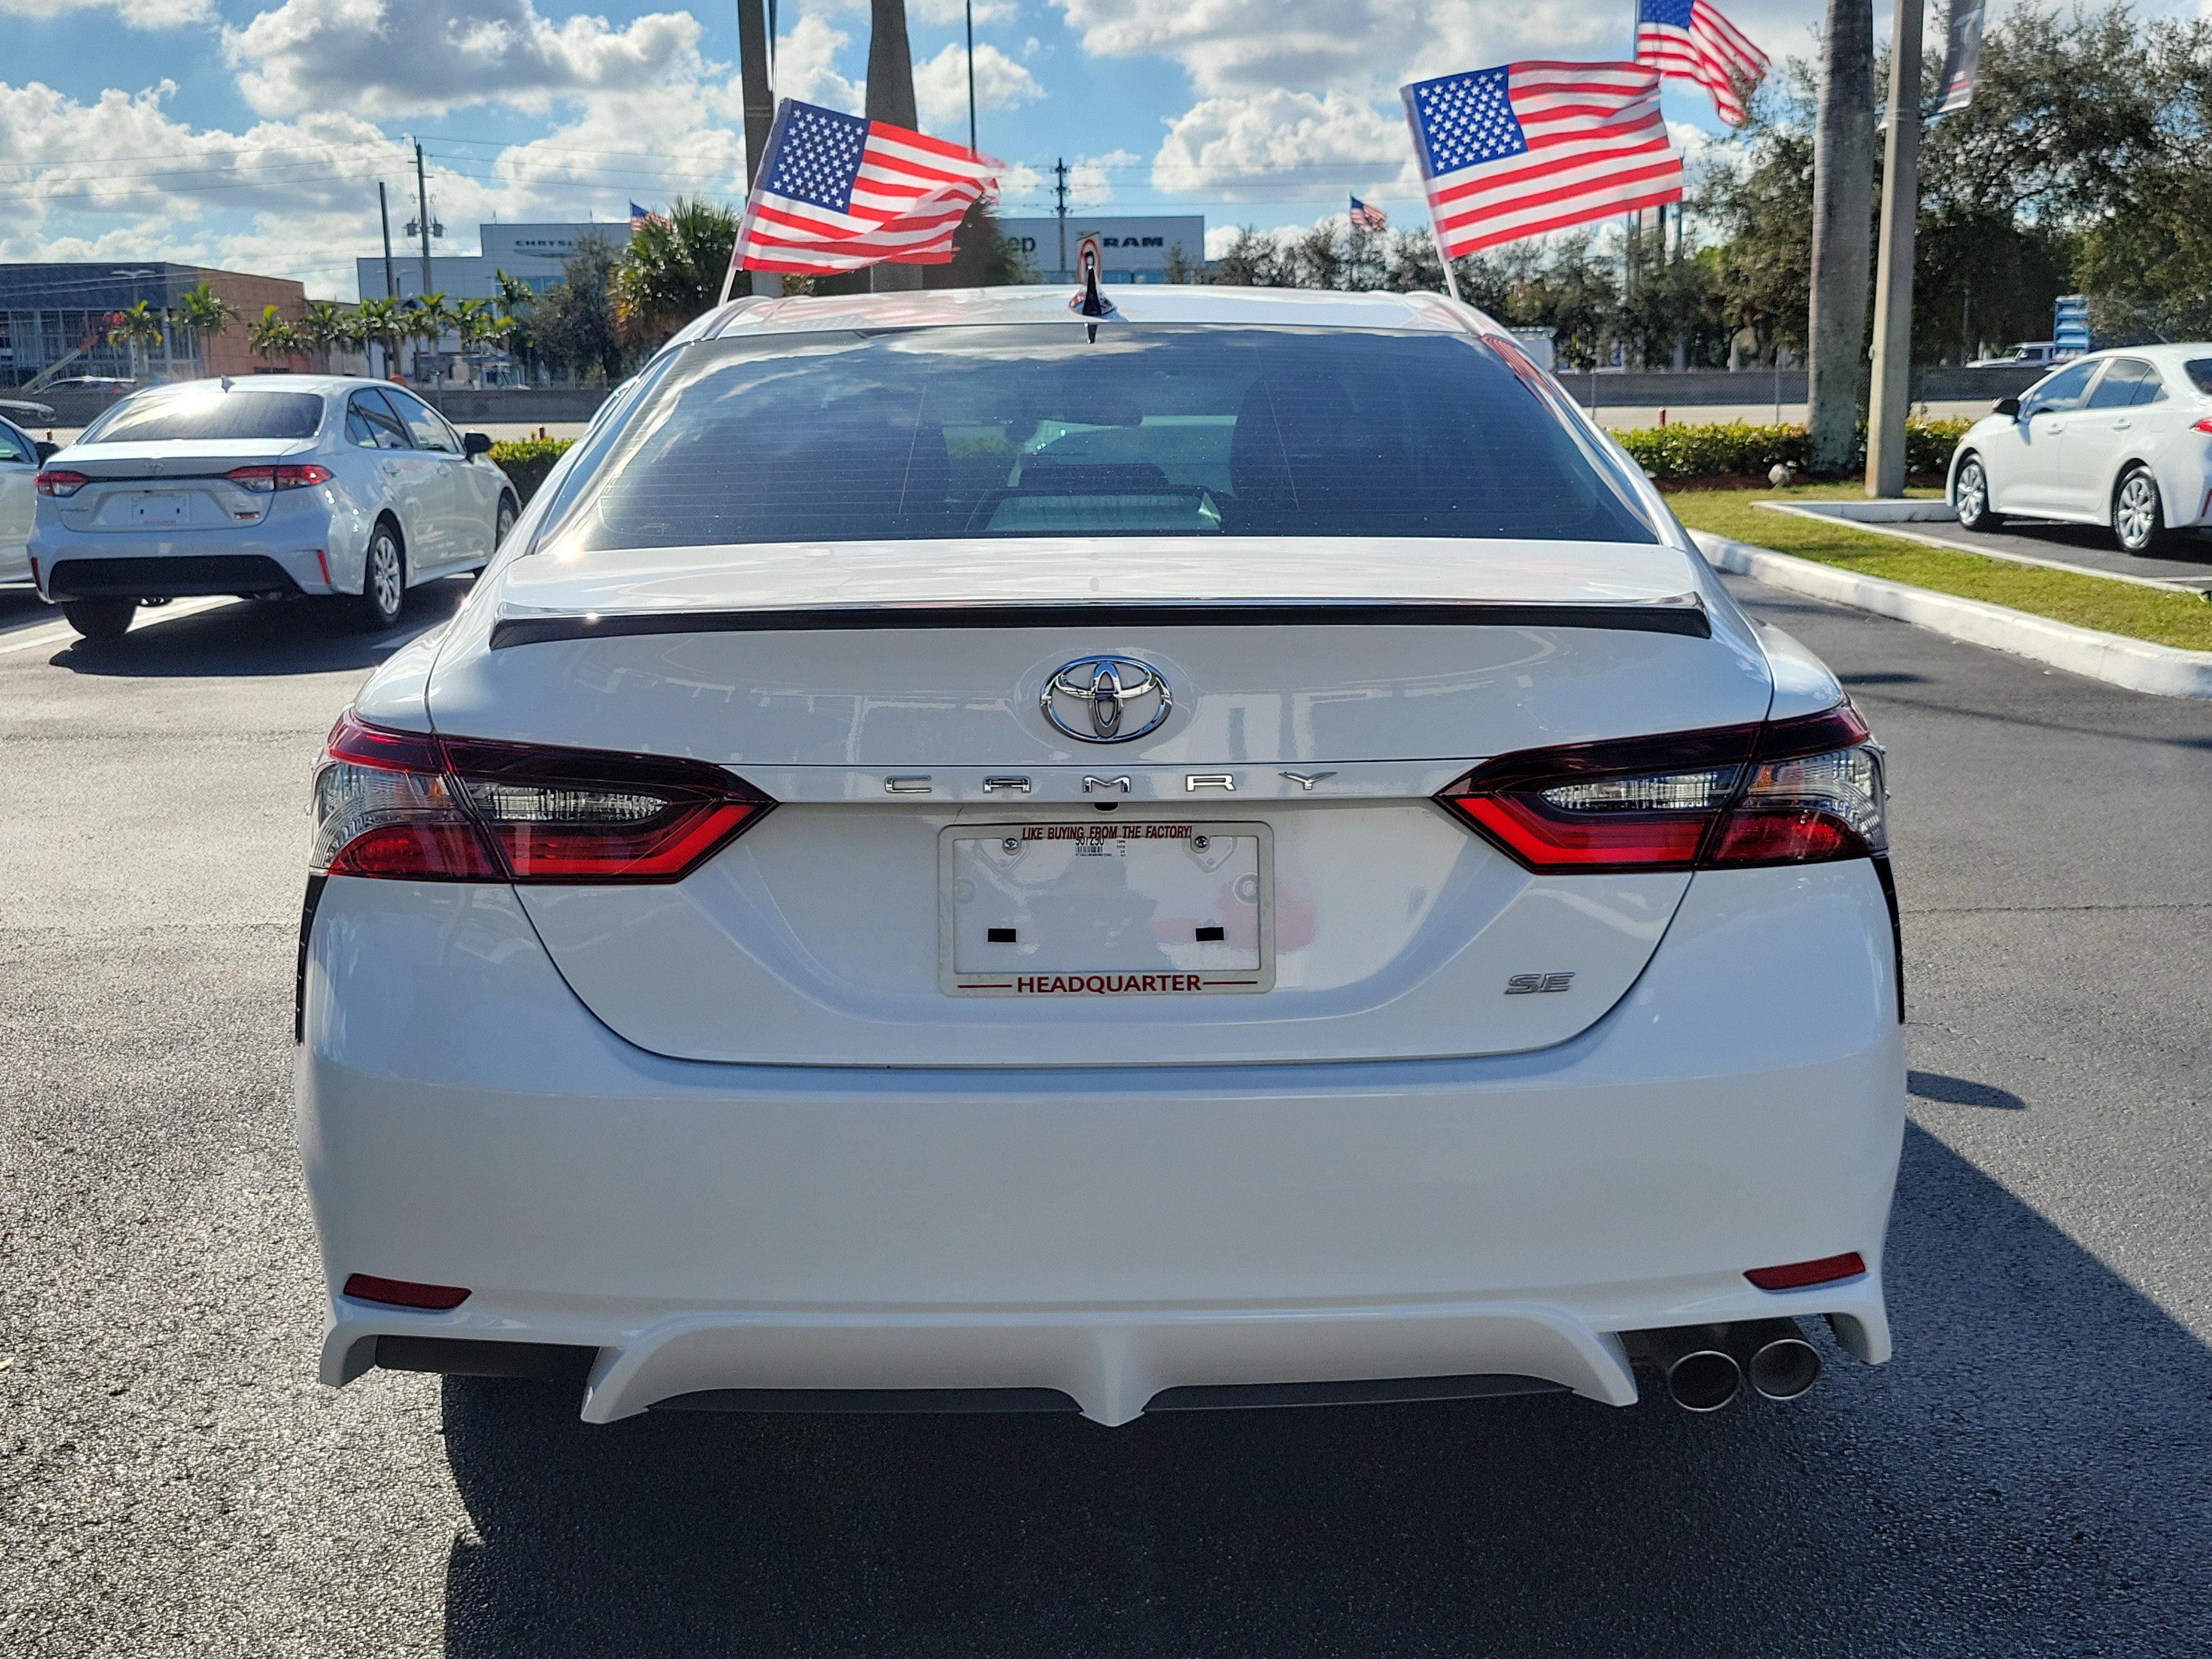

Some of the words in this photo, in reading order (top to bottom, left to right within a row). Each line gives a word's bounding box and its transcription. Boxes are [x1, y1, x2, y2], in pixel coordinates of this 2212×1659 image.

[1103, 237, 1163, 247] RAM
[884, 770, 1338, 794] CAMRY
[1022, 827, 1043, 840] LIKE
[1048, 826, 1084, 840] BUYING
[1090, 826, 1118, 839] FROM
[1122, 826, 1141, 839] THE
[1146, 825, 1192, 839] FACTORY!
[1017, 974, 1201, 994] HEADQUARTER
[1503, 972, 1576, 995] SE
